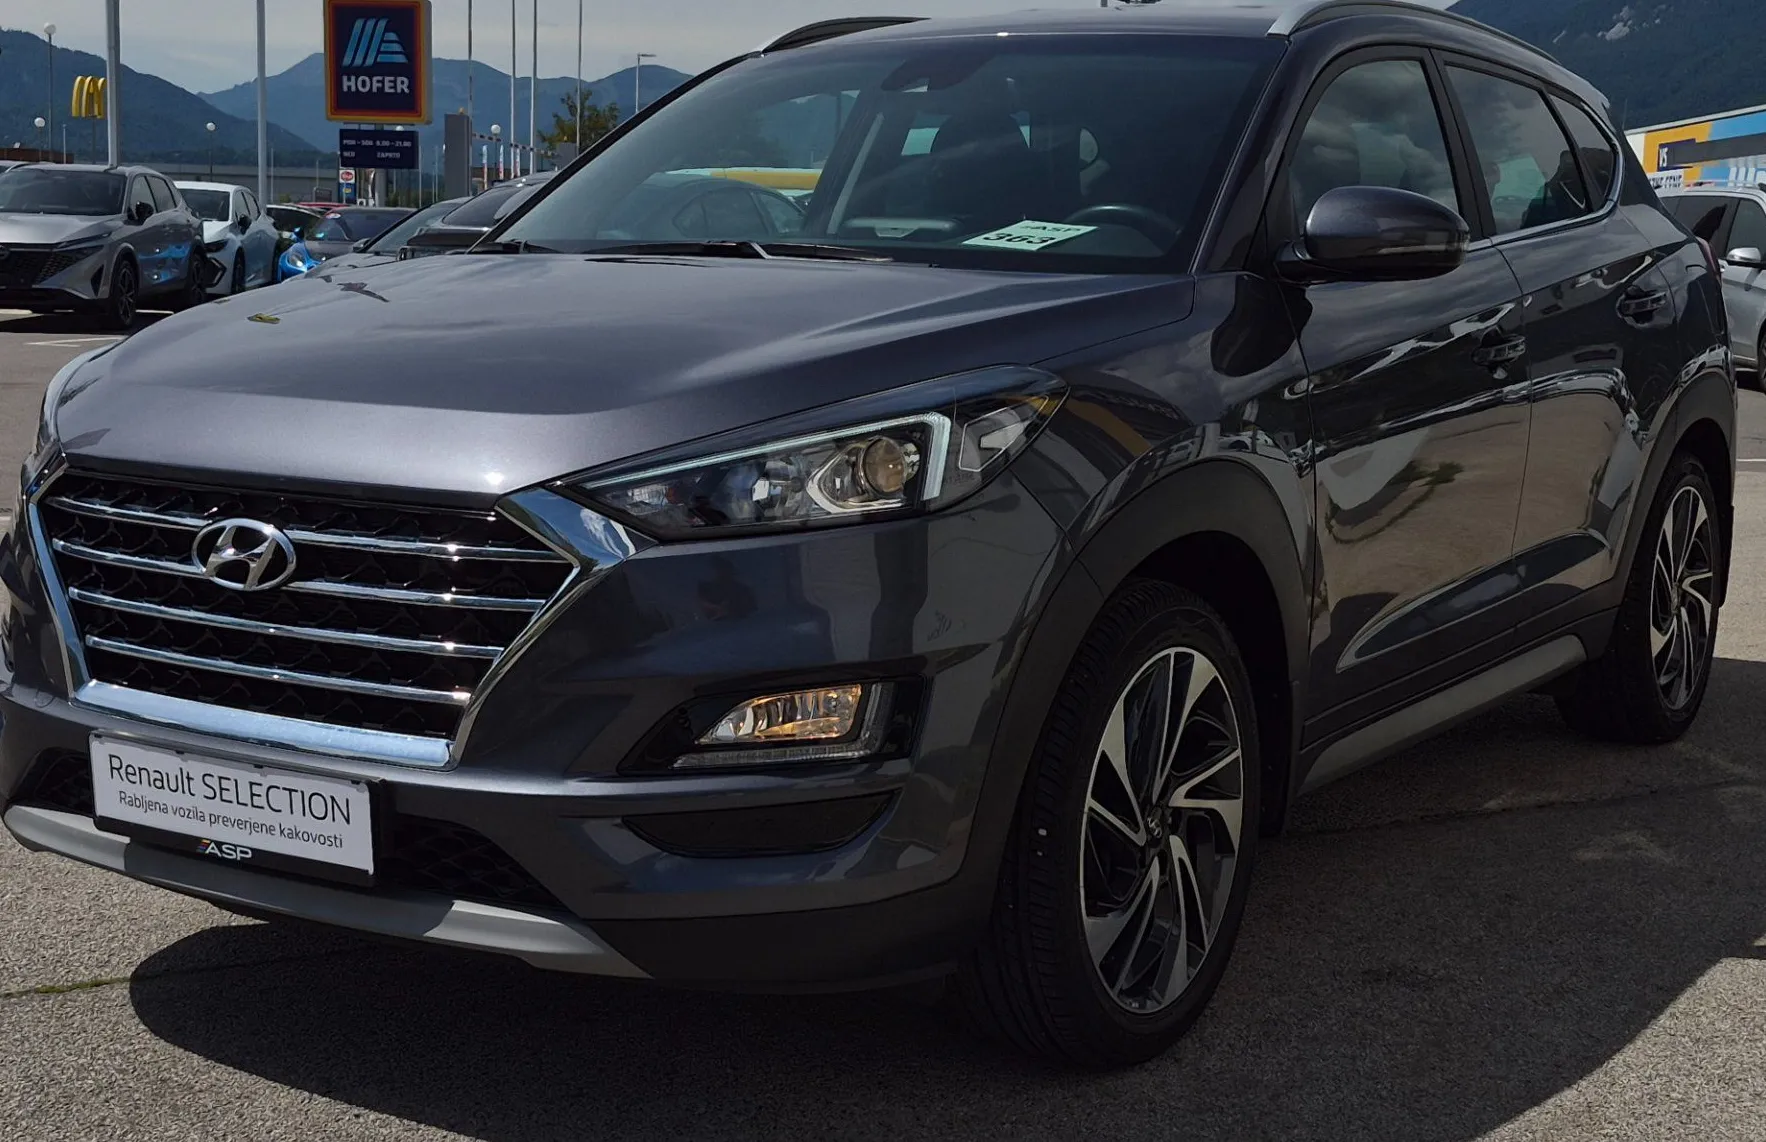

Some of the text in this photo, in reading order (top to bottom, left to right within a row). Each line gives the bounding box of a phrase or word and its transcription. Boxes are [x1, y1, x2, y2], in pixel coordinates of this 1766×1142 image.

[342, 75, 410, 94] HOFER
[108, 753, 350, 825] Renault SELECTION
[119, 790, 343, 849] Rabljena vozila preverjene kakovosti
[203, 840, 252, 861] ASP
